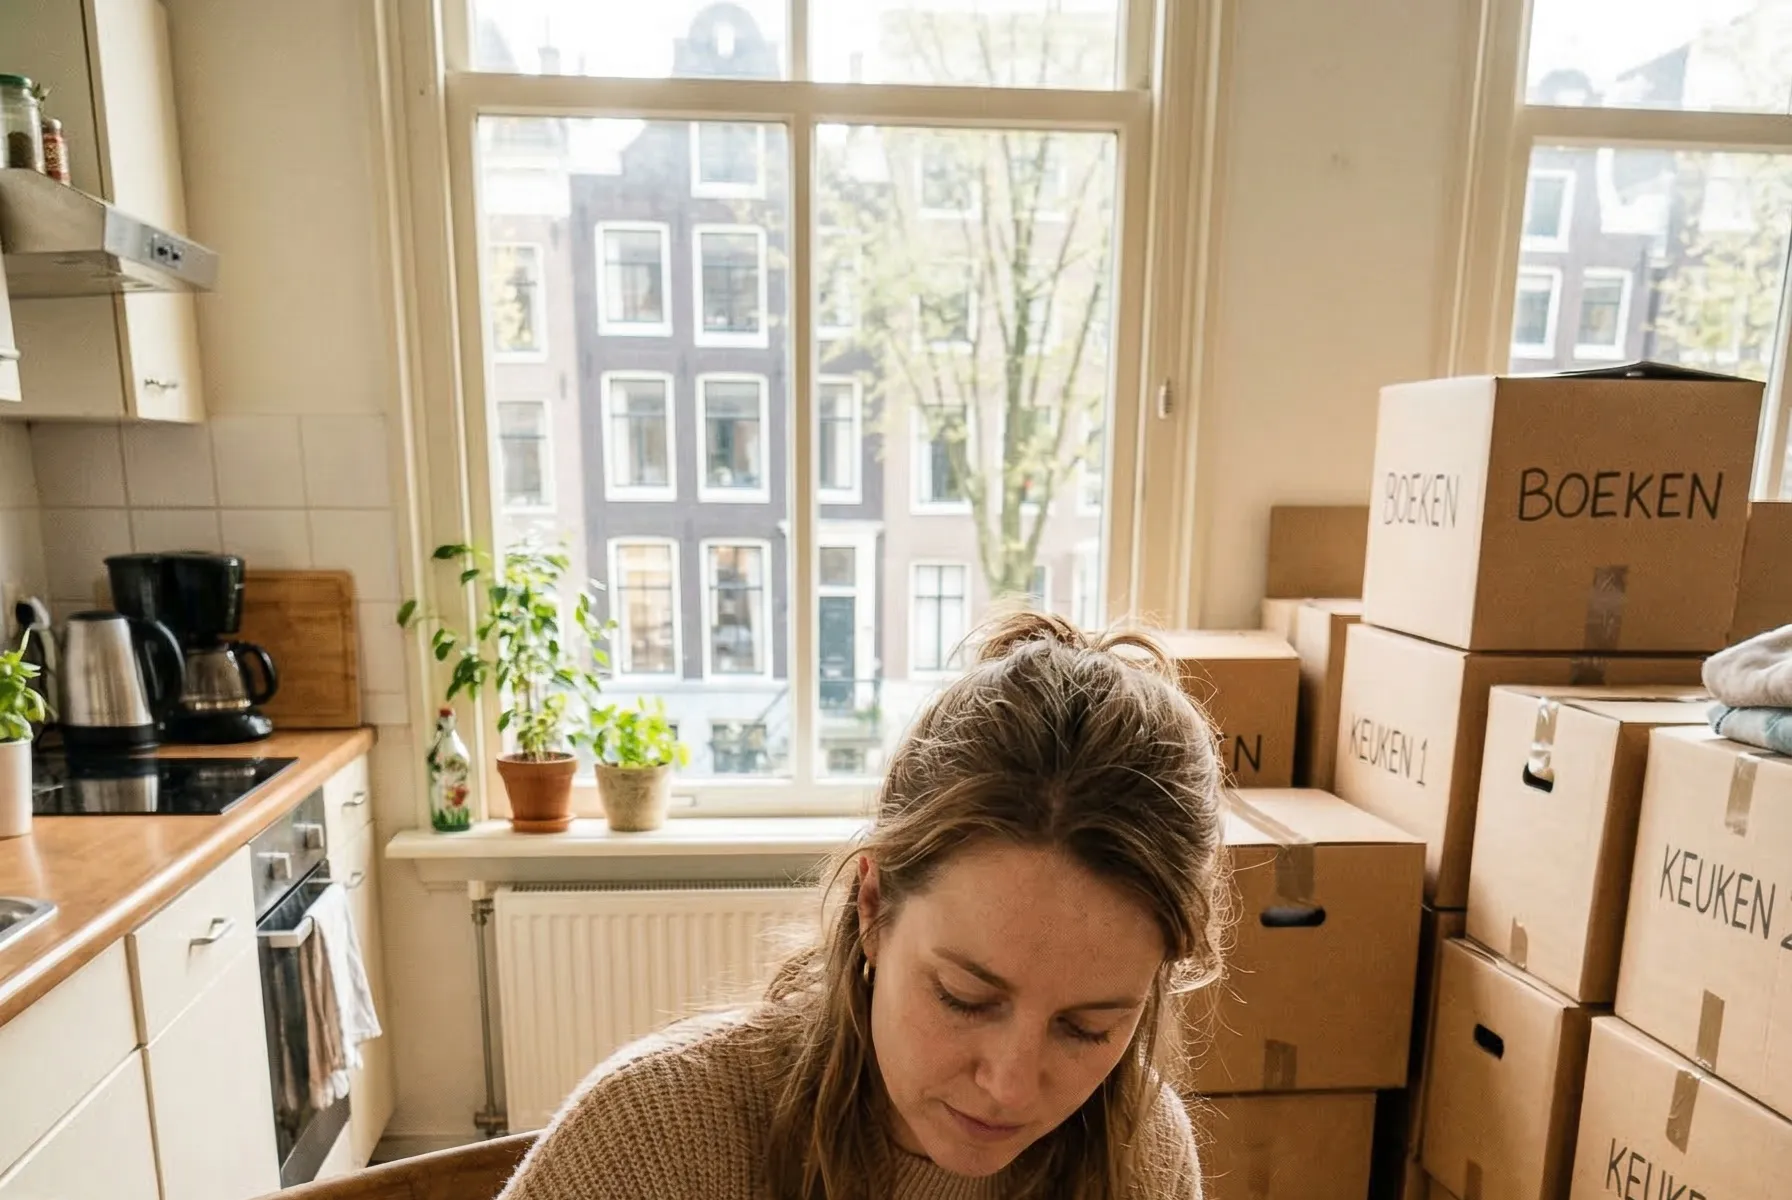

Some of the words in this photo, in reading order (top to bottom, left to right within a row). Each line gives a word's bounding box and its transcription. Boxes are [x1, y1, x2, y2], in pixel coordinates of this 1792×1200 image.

[1384, 471, 1460, 528] BOEKEN
[1517, 467, 1723, 522] BOEKEN
[1348, 713, 1414, 779] KEUKEN
[1416, 738, 1428, 788] 1
[1660, 843, 1776, 940] KEUKEN
